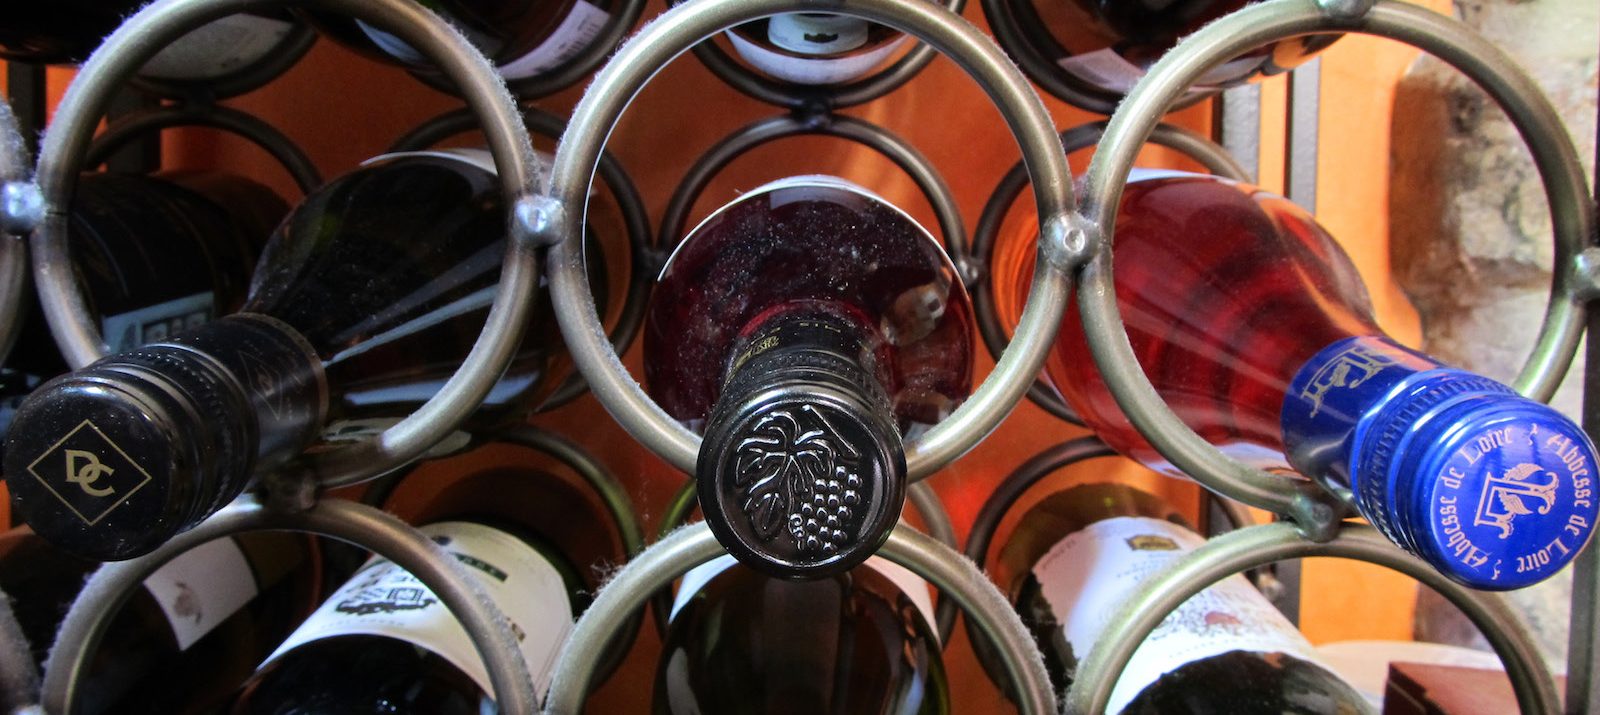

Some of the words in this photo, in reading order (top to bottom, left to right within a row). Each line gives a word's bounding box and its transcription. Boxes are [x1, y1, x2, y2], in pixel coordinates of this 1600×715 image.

[1459, 427, 1513, 465] Loire
[64, 449, 115, 497] DC
[1441, 467, 1465, 489] de
[1546, 434, 1591, 508] Abbesse
[1440, 496, 1490, 569] Abbesse
[1565, 514, 1588, 536] de
[1517, 538, 1570, 573] Loire
